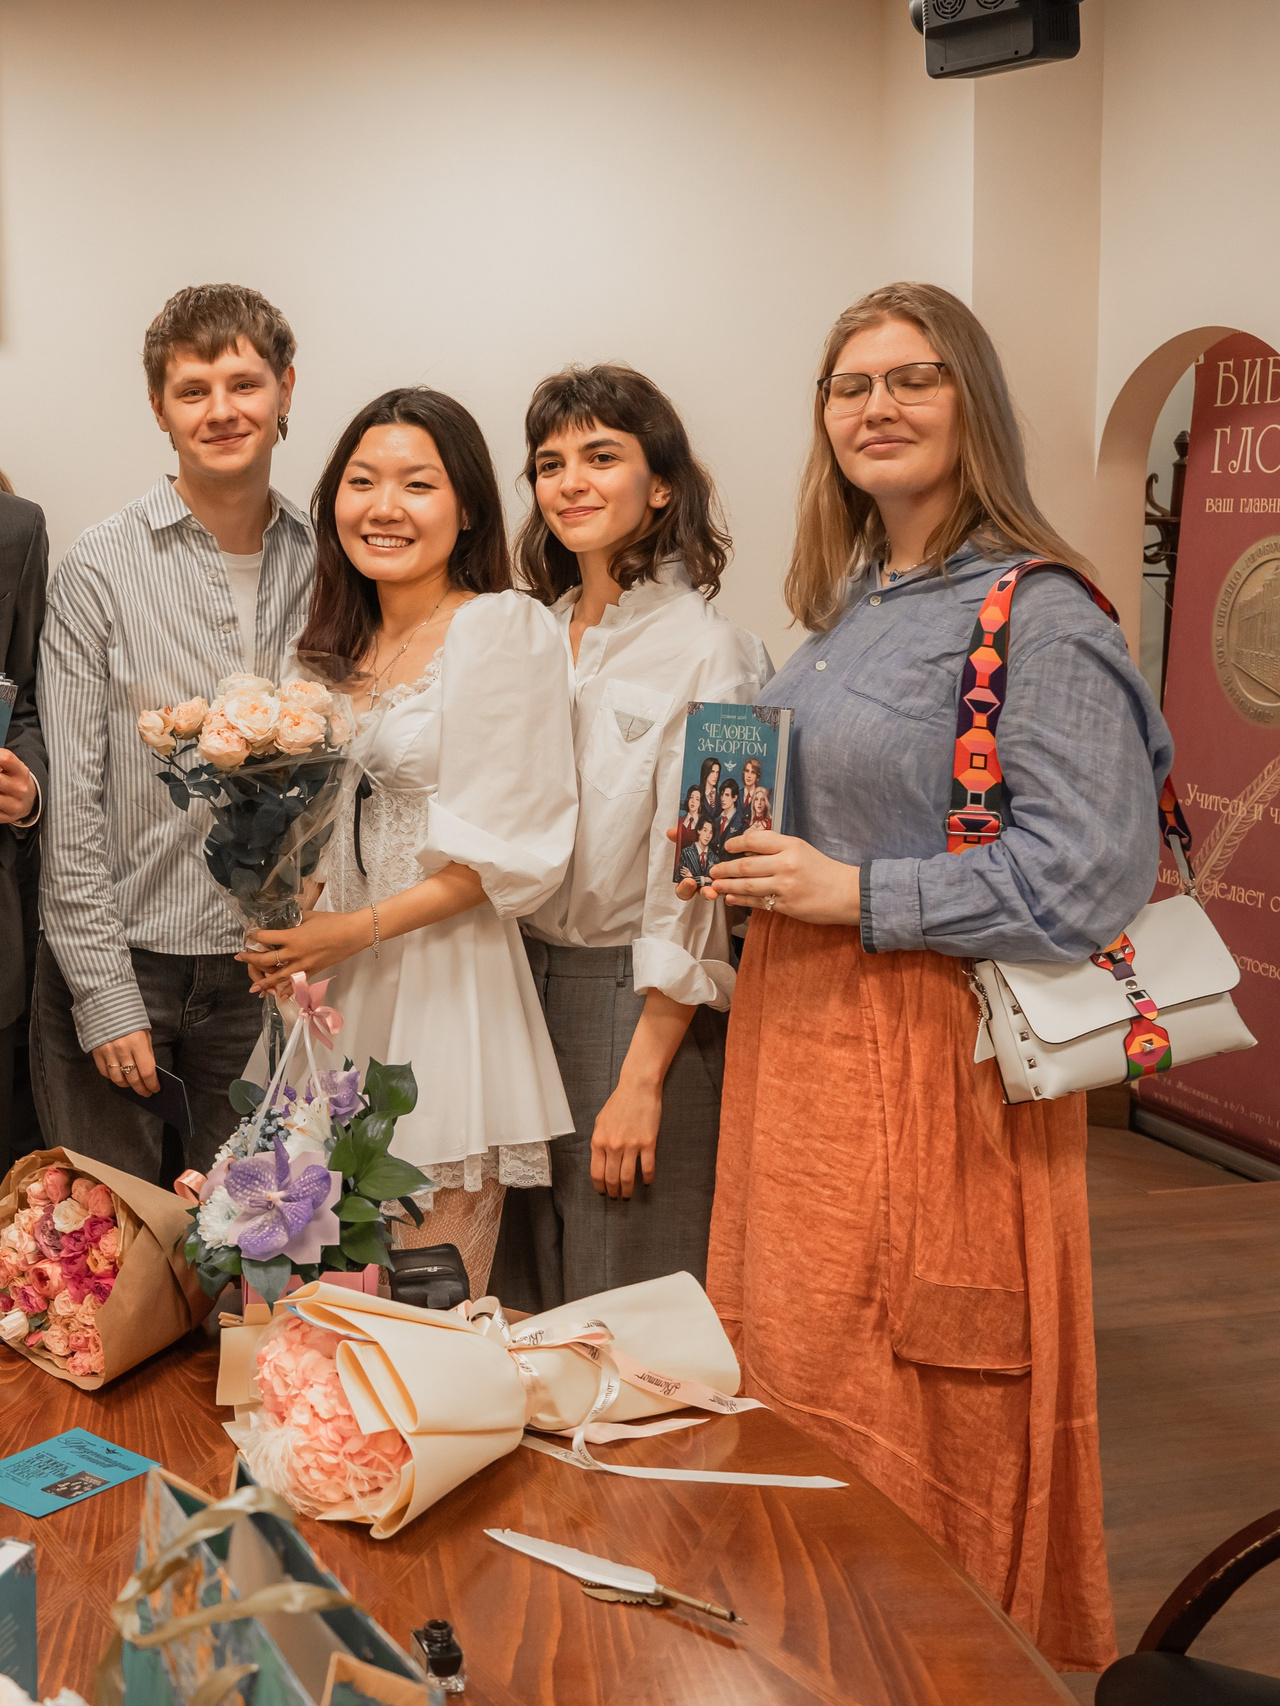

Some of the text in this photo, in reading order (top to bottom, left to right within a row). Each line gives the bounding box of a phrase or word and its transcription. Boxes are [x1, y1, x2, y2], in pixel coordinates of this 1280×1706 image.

[1205, 498, 1234, 513] ваш
[702, 722, 762, 742] ЧЕЛОВЕК
[697, 737, 767, 757] ЗА БОРТОМ
[1201, 878, 1265, 908] сделает
[634, 1372, 682, 1397] Blommor
